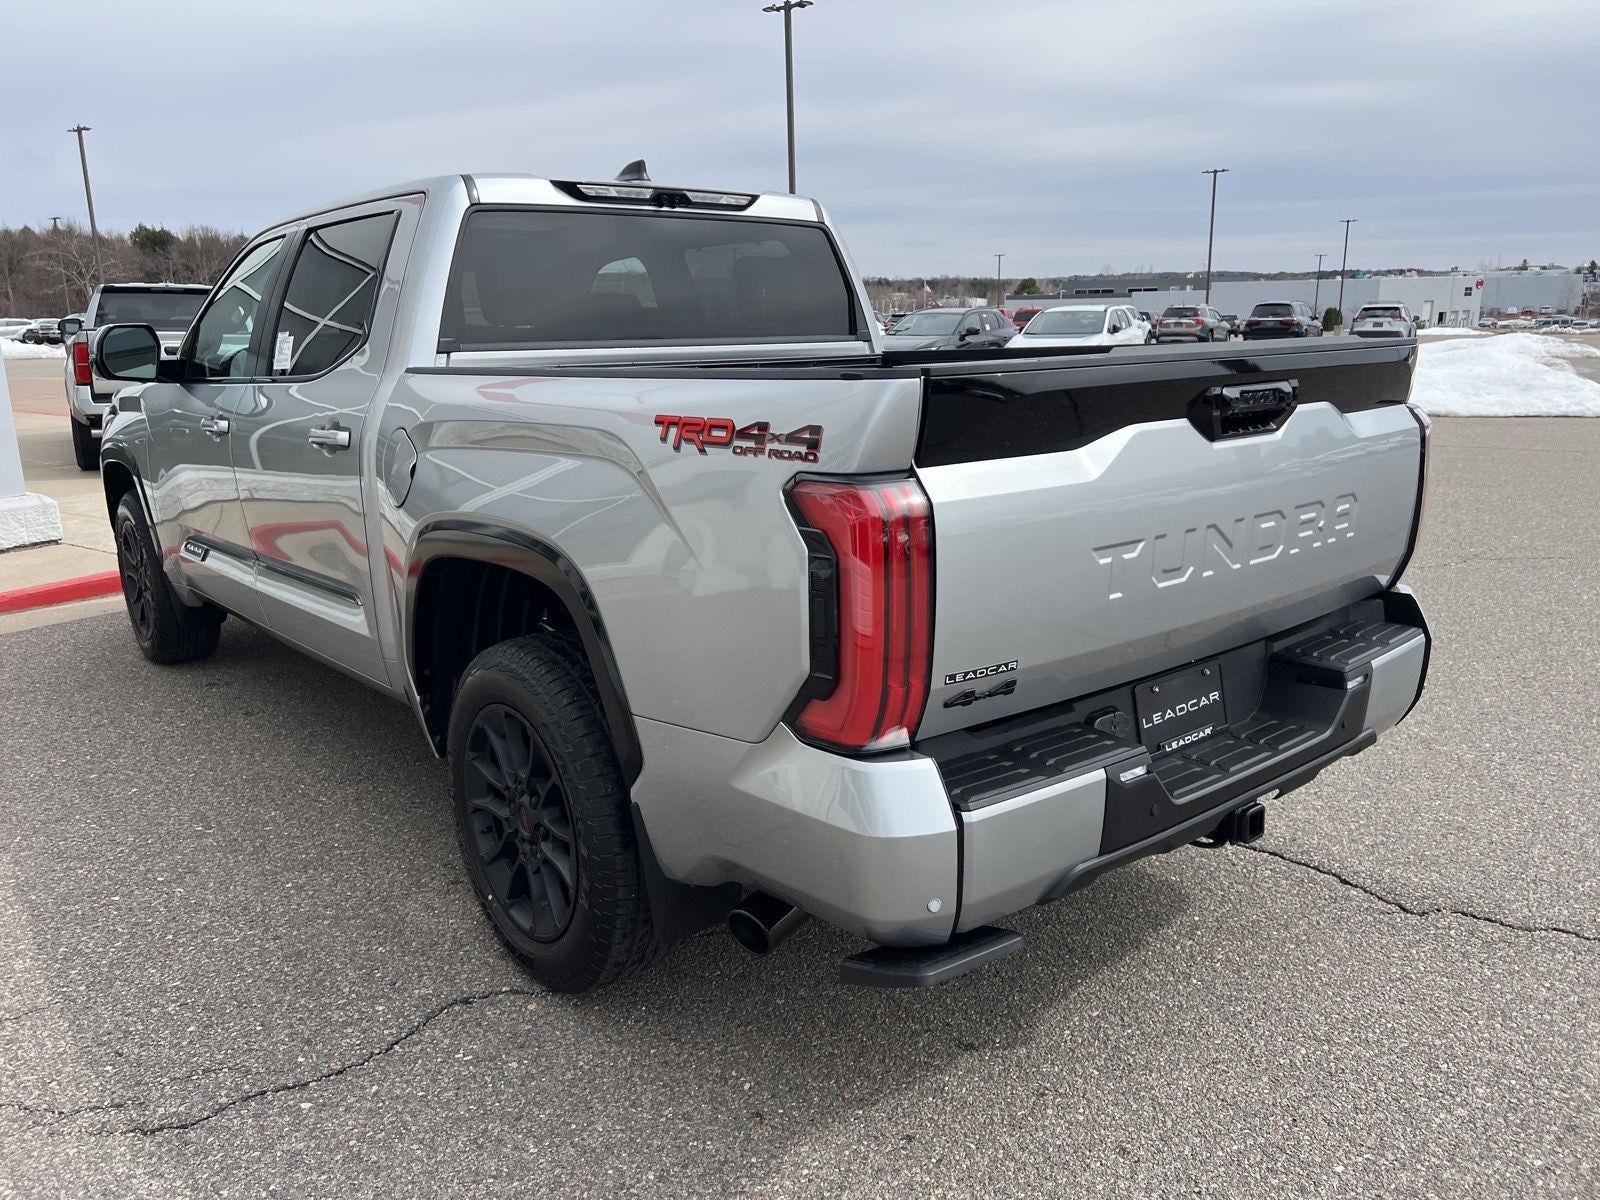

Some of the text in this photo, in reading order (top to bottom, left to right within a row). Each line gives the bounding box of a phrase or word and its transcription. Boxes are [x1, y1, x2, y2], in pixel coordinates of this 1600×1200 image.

[654, 414, 735, 456] TRD
[732, 446, 819, 464] OFF ROAD
[1092, 492, 1358, 600] TUNDRA
[945, 661, 1018, 684] LEADCAR
[1142, 691, 1220, 729] LEADCAR
[1165, 726, 1213, 752] LEADCAR
